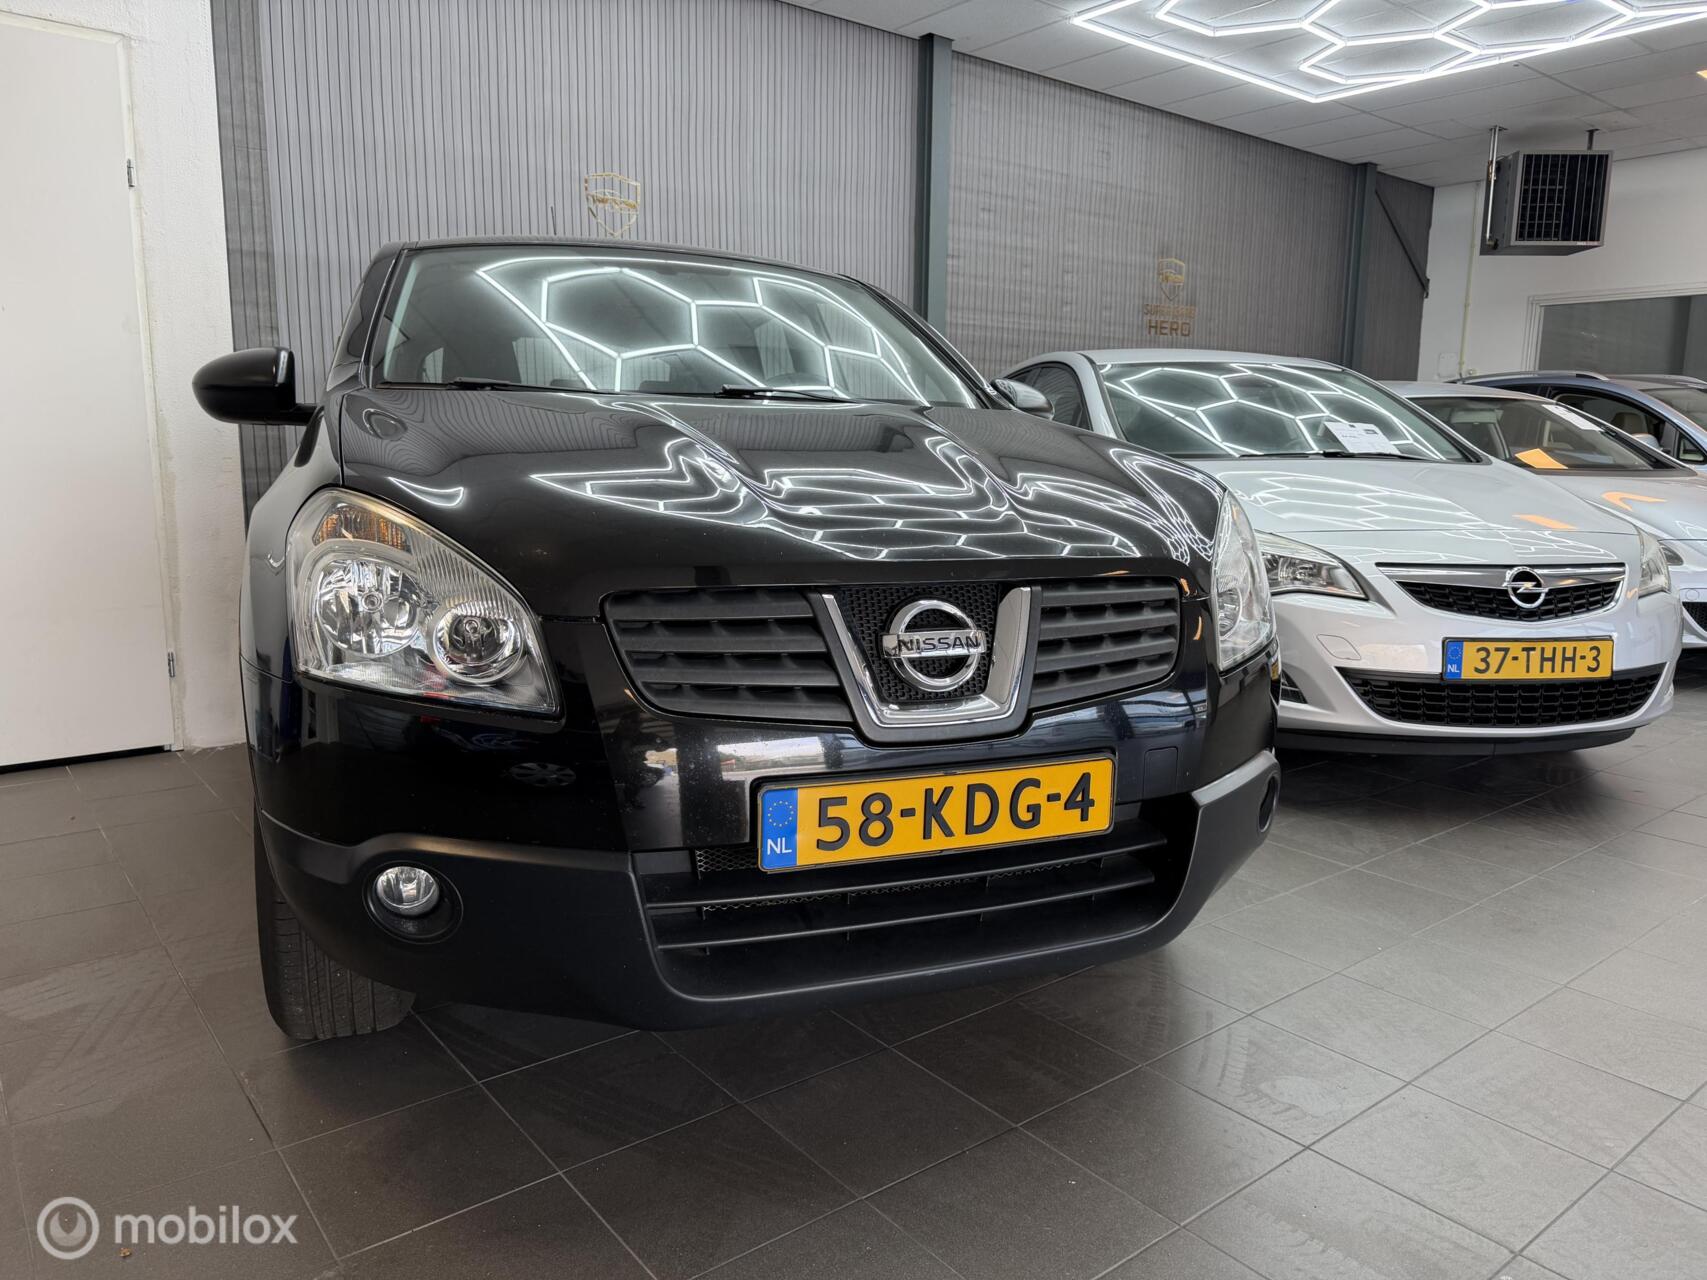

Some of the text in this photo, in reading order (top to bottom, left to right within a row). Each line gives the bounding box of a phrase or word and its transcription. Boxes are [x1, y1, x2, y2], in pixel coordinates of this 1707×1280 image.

[1148, 319, 1191, 337] HERO
[898, 635, 981, 653] NISSAN
[1447, 645, 1601, 674] NL 37-THH-3
[767, 771, 1096, 856] NL 58-KDG-4
